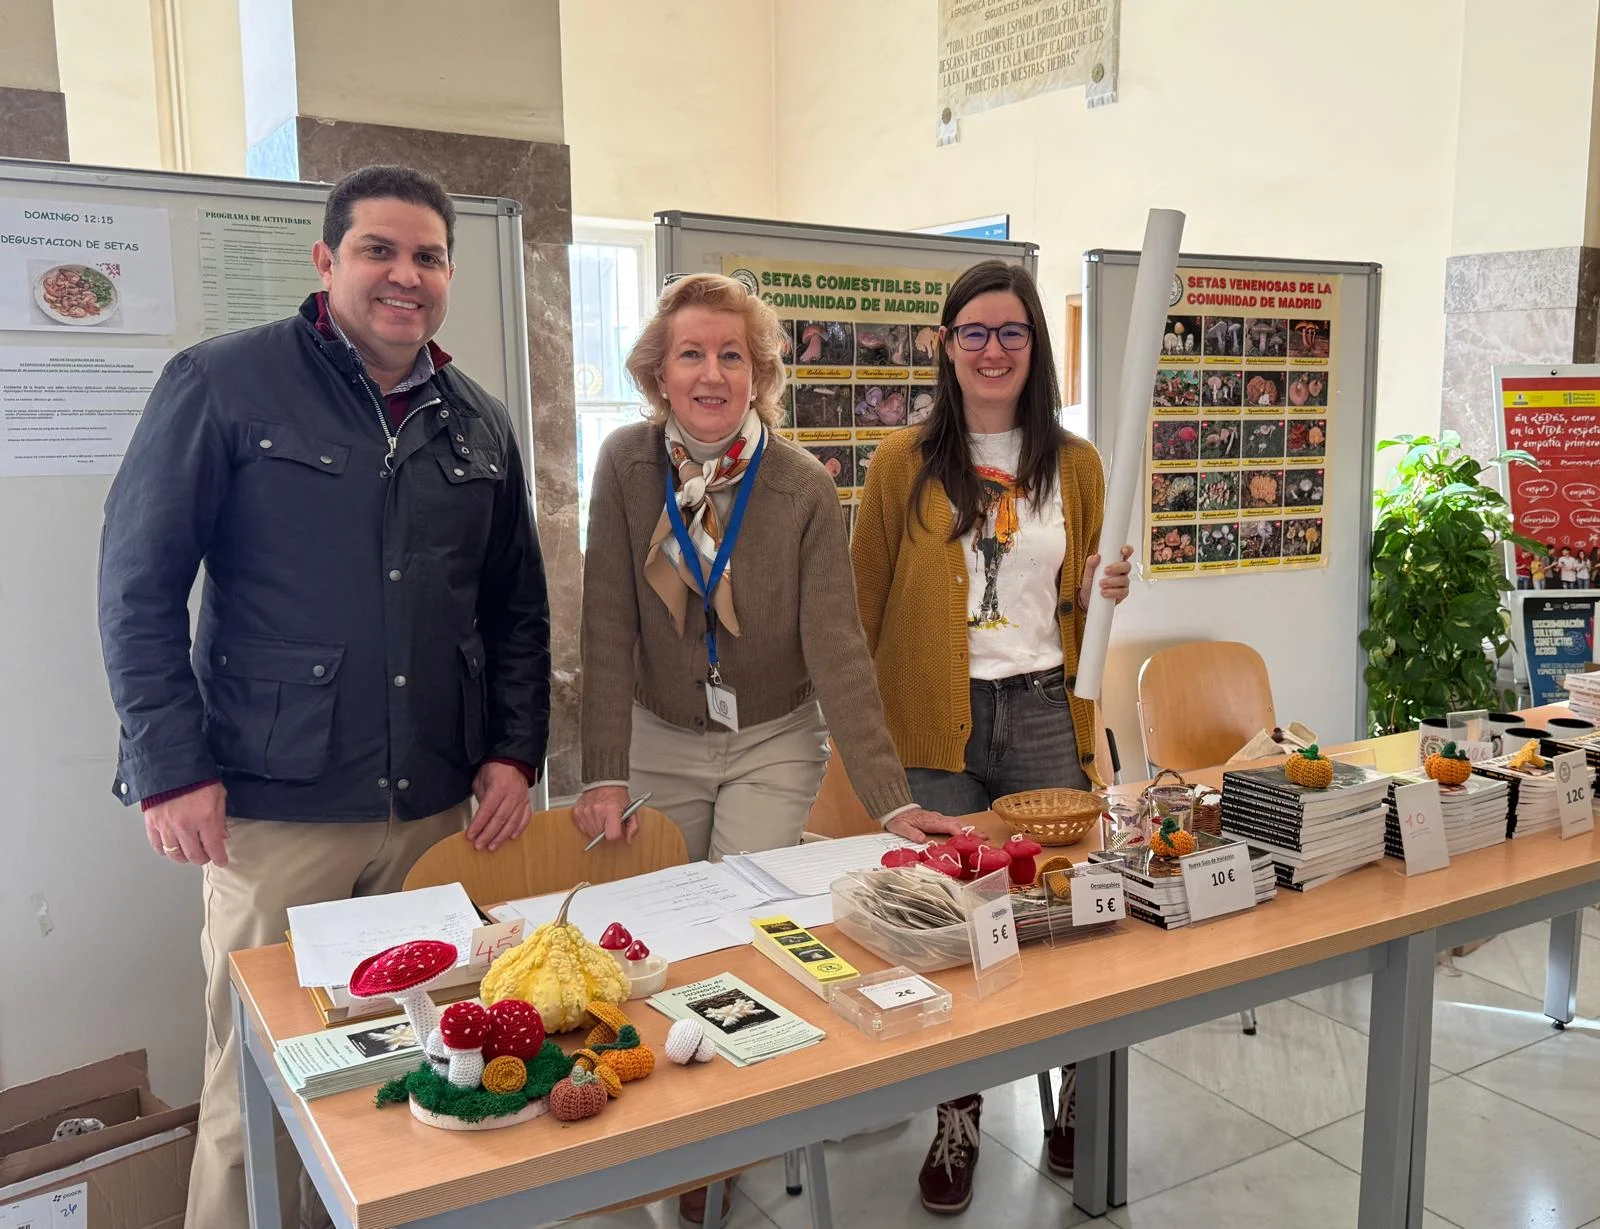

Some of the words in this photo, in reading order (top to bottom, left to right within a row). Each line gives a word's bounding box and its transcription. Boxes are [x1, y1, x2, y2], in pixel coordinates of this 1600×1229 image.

[1016, 32, 1025, 48] EN
[24, 210, 79, 222] DOMINGO
[84, 214, 114, 225] 12:15
[205, 211, 249, 221] PROGRAMA
[263, 216, 312, 225] ACTIVIDADES
[0, 234, 82, 248] DEGUSTACION
[86, 240, 100, 249] DE
[104, 241, 139, 251] SETAS
[761, 271, 812, 289] SETAS
[816, 275, 921, 294] COMESTIBLES
[924, 281, 943, 295] DE
[1187, 276, 1227, 289] SETAS
[1230, 278, 1297, 293] VENENOSAS
[1299, 281, 1315, 293] DE
[1317, 283, 1332, 294] LA
[762, 292, 857, 311] COMUNIDAD
[860, 298, 880, 312] DE
[884, 299, 939, 314] MADRID
[1187, 293, 1257, 307] COMUNIDAD
[1259, 297, 1276, 308] DE
[1278, 297, 1322, 310] MADRID
[1510, 428, 1522, 437] en
[1524, 426, 1534, 435] la
[1513, 441, 1520, 450] y
[1566, 787, 1585, 804] 12€
[1212, 871, 1226, 887] 10
[1228, 868, 1236, 882] €
[1096, 898, 1104, 914] 5
[1107, 897, 1116, 913] €
[992, 928, 999, 944] 5
[1001, 924, 1009, 940] €
[895, 989, 916, 998] 2€
